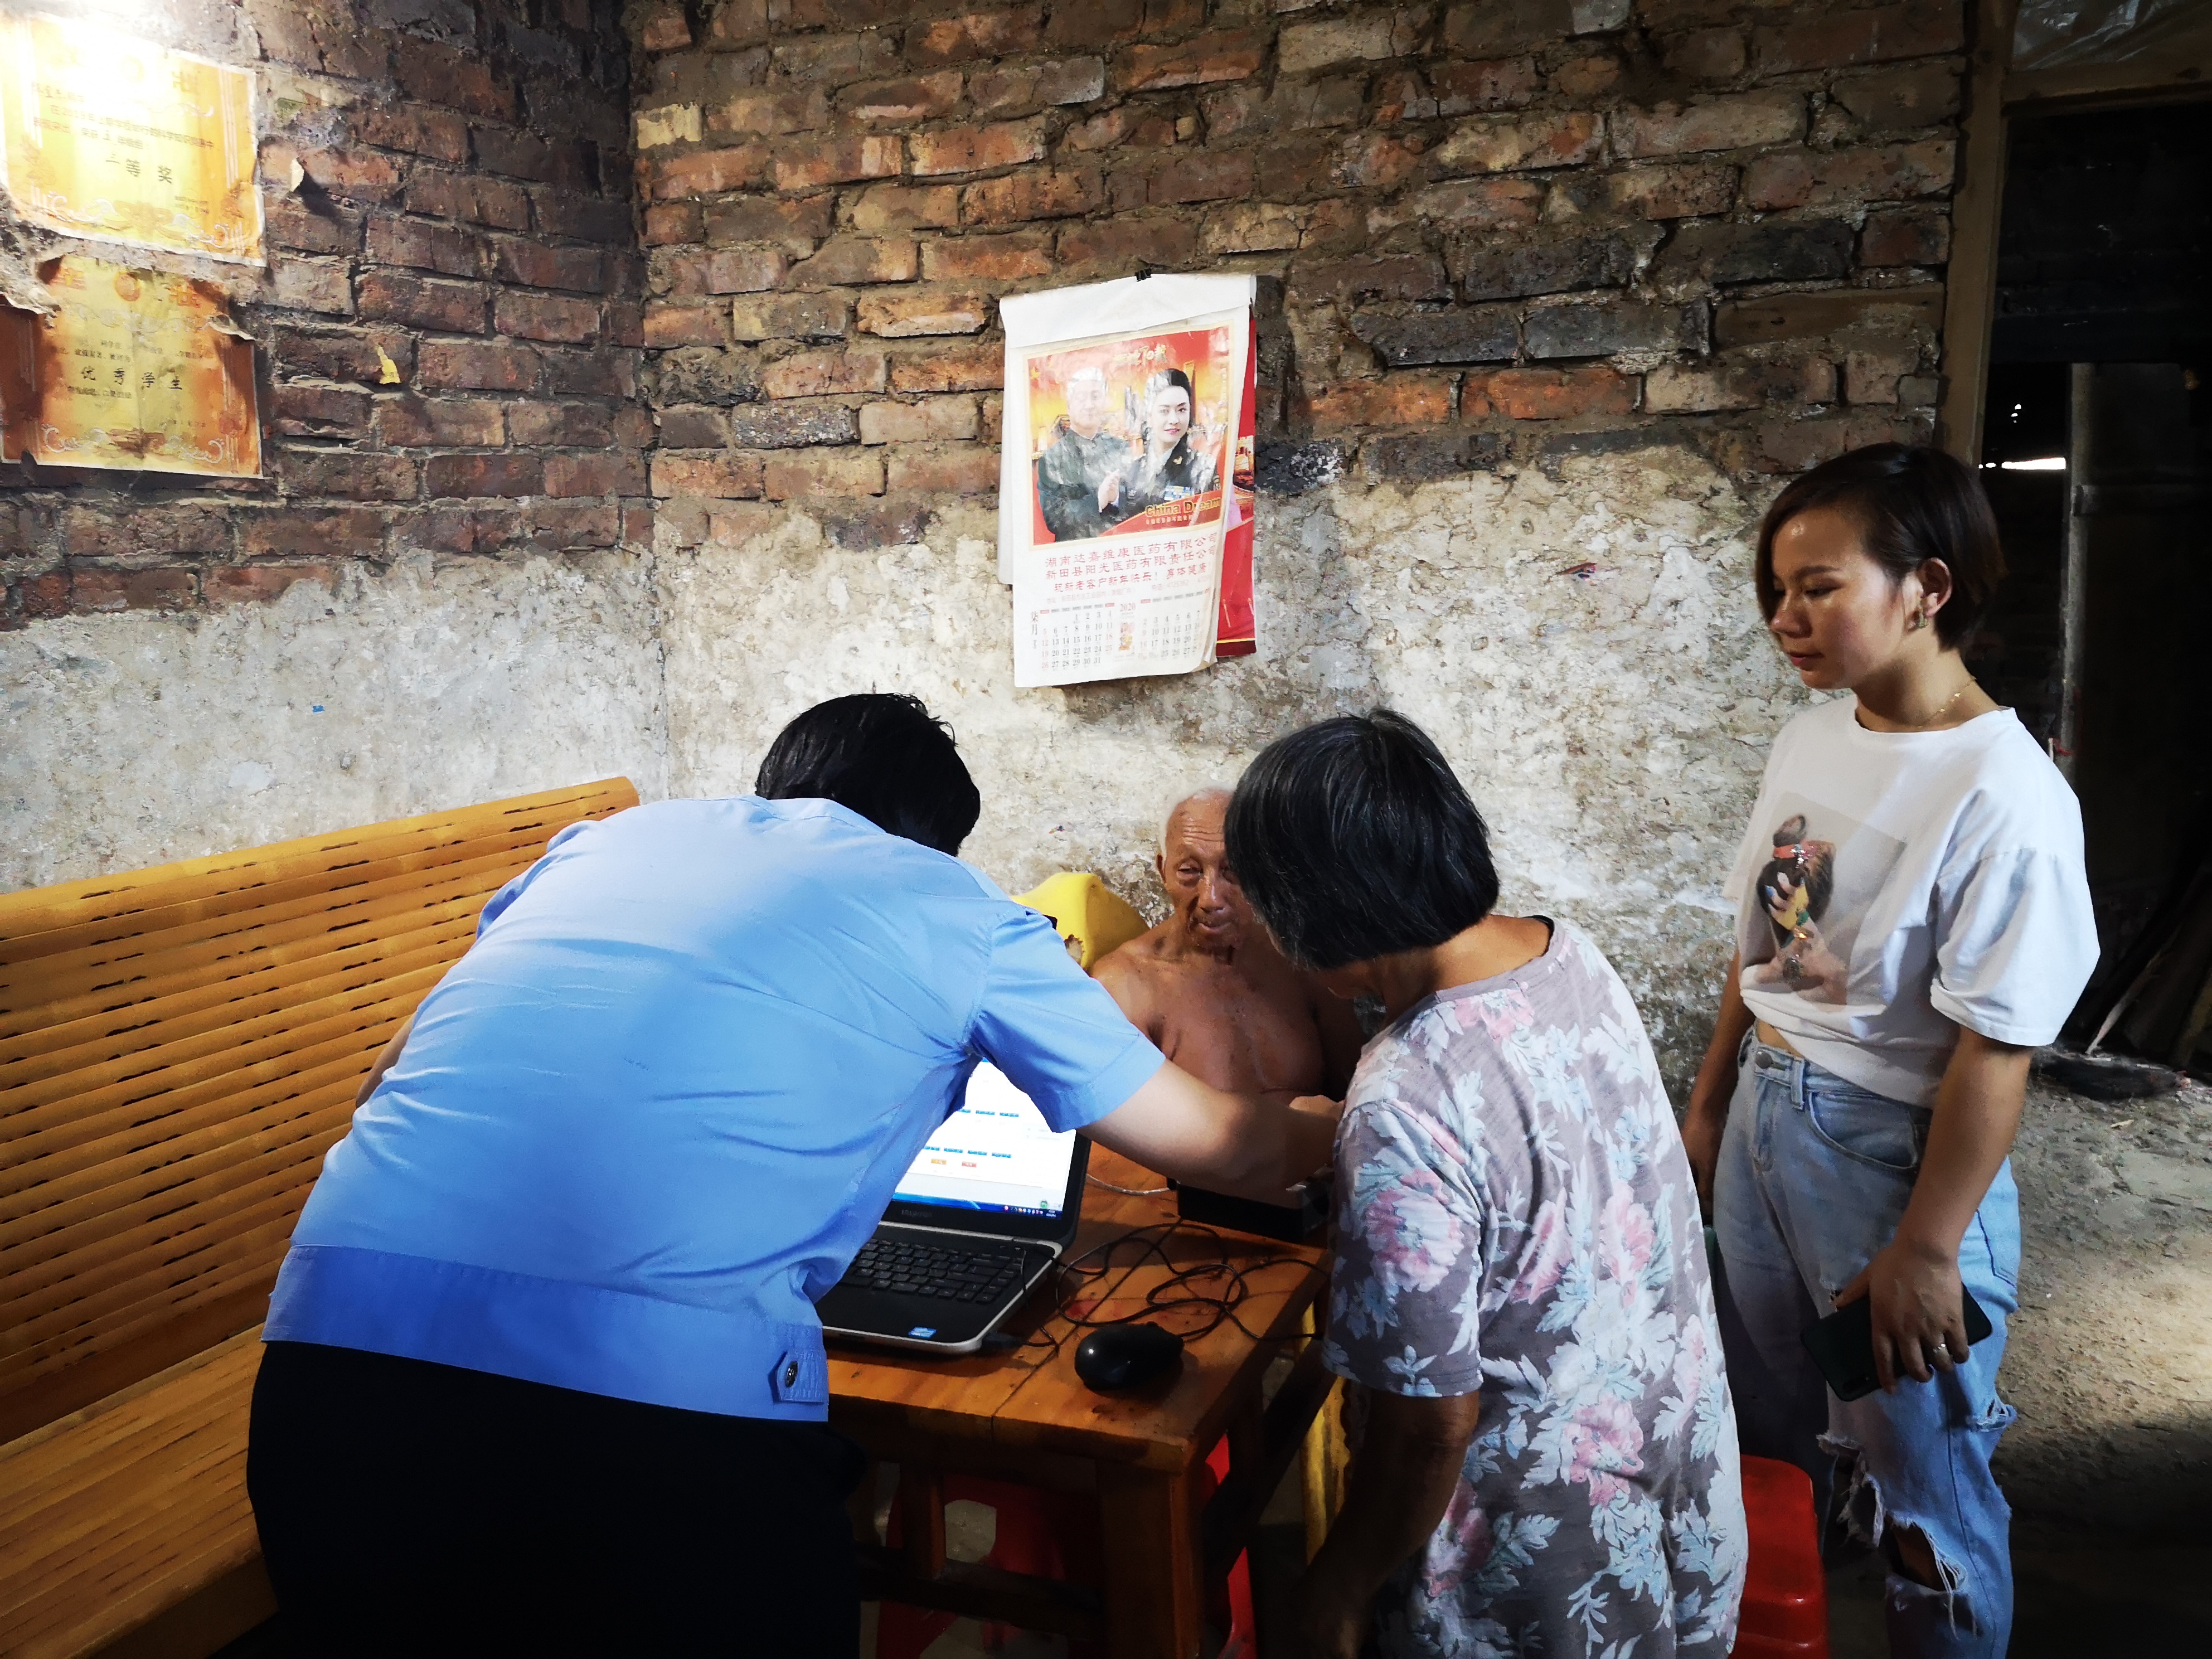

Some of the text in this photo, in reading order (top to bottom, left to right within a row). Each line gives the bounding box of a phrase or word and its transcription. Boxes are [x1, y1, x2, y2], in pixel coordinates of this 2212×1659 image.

[81, 367, 182, 390] 优秀学生
[1145, 505, 1181, 517] China
[1045, 532, 1217, 567] 湖南达嘉维康医药有限公司
[1046, 545, 1216, 580] 新田县阳光医药有限责任公司
[1120, 603, 1136, 612] 2020
